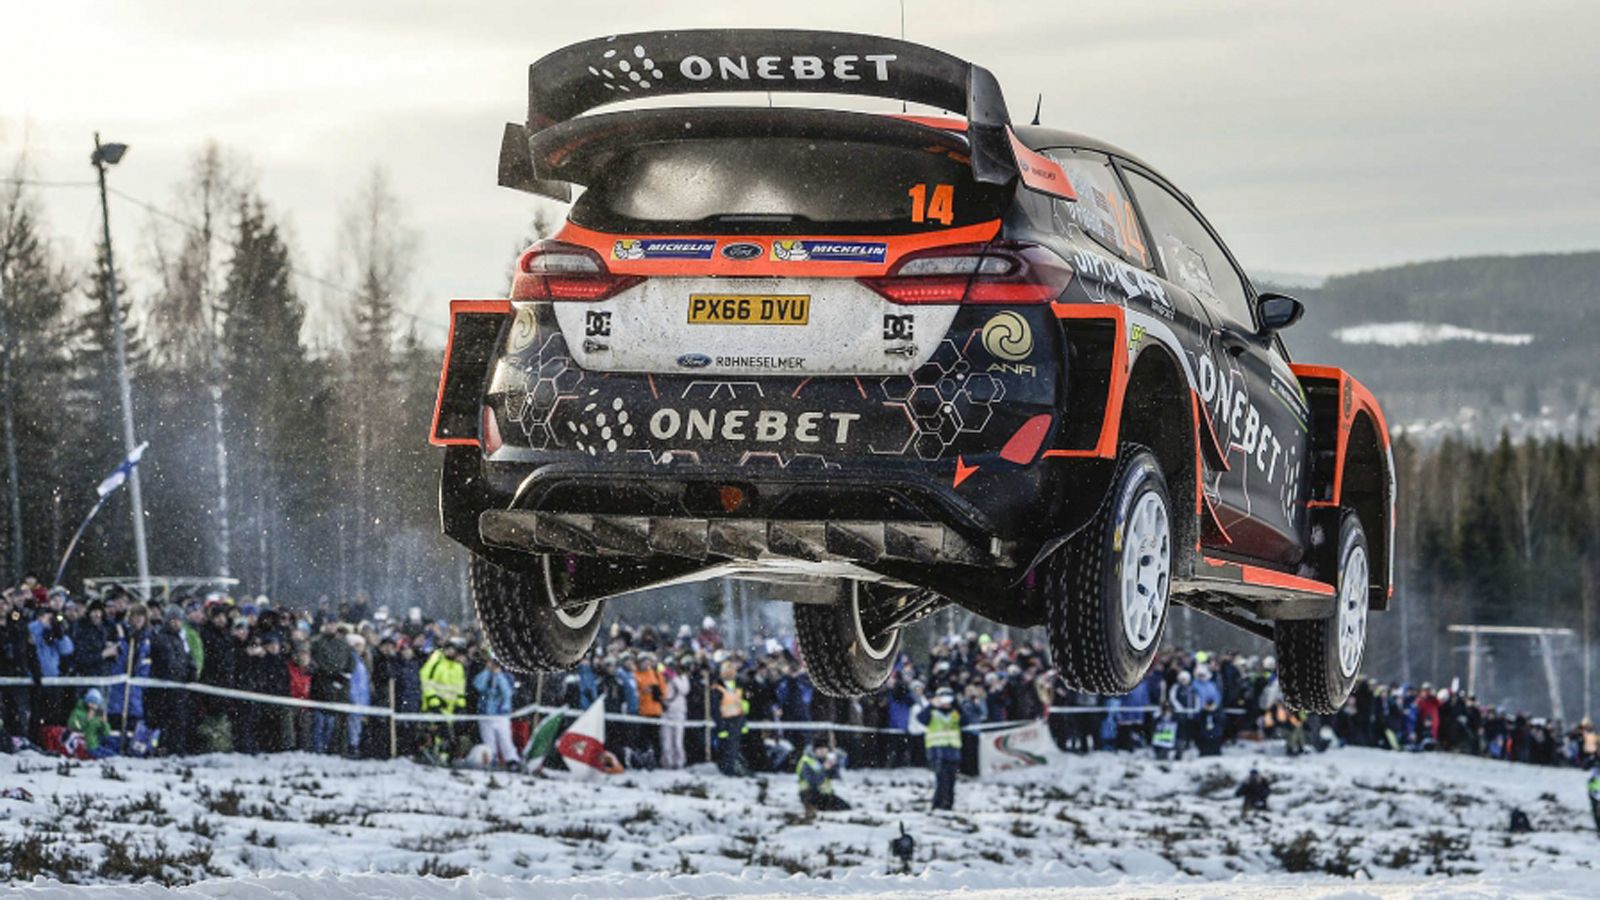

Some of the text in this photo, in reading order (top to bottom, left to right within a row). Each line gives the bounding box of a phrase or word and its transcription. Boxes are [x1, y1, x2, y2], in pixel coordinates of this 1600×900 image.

[680, 54, 897, 82] ONEBET
[908, 184, 954, 225] 14
[647, 243, 714, 253] MICHELIN
[812, 244, 885, 256] MICHELIN
[692, 297, 804, 321] PX66 DVU
[986, 362, 1037, 378] ANFI
[649, 408, 861, 444] ONEBET
[1199, 354, 1281, 484] ONEBET
